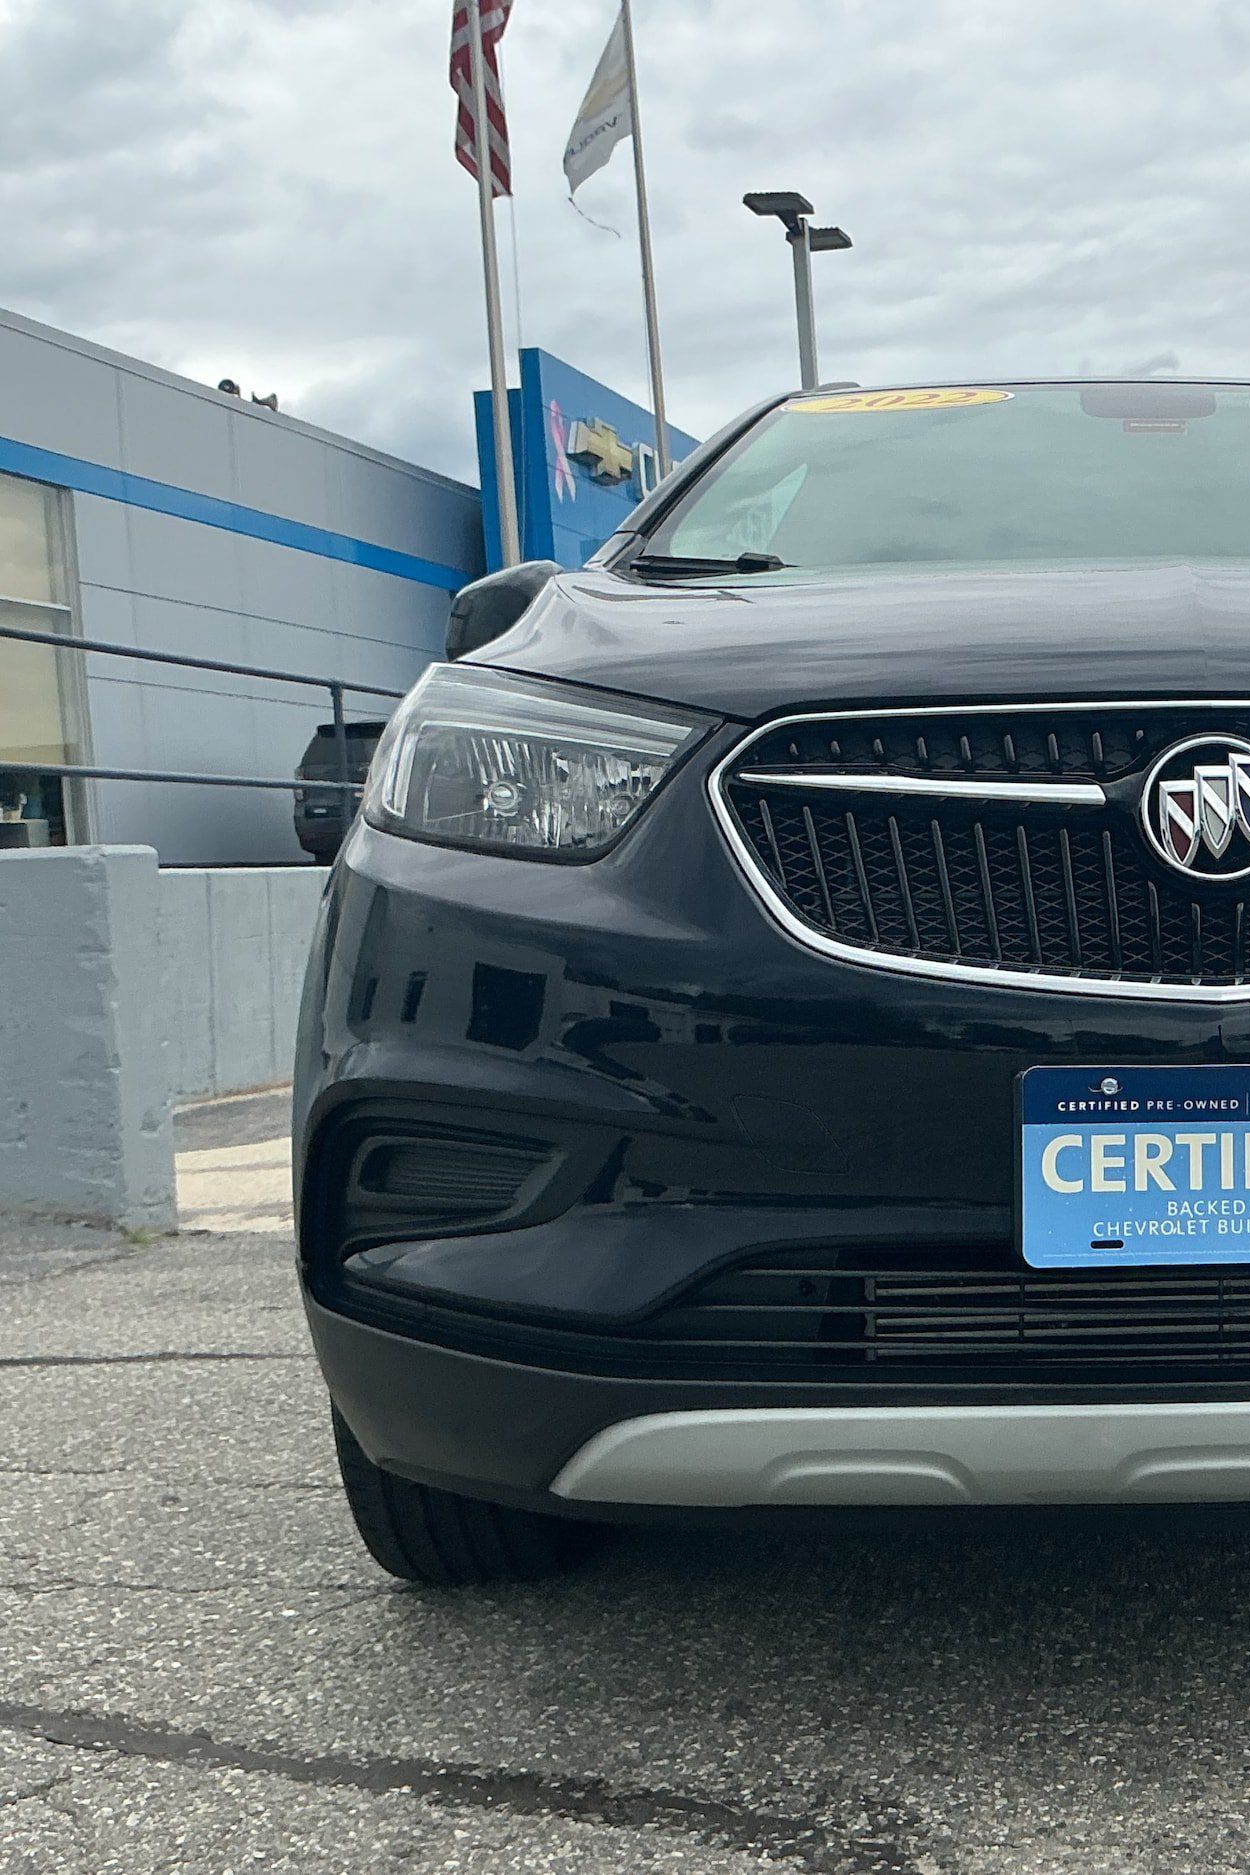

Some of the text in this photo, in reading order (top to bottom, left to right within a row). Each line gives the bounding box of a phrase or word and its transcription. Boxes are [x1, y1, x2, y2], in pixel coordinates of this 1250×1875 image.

[821, 391, 978, 411] 2022
[1057, 1099, 1239, 1112] CERTIFIED PRE-OWNED
[1167, 1200, 1245, 1217] BACKED
[1093, 1219, 1209, 1238] CHEVROLET
